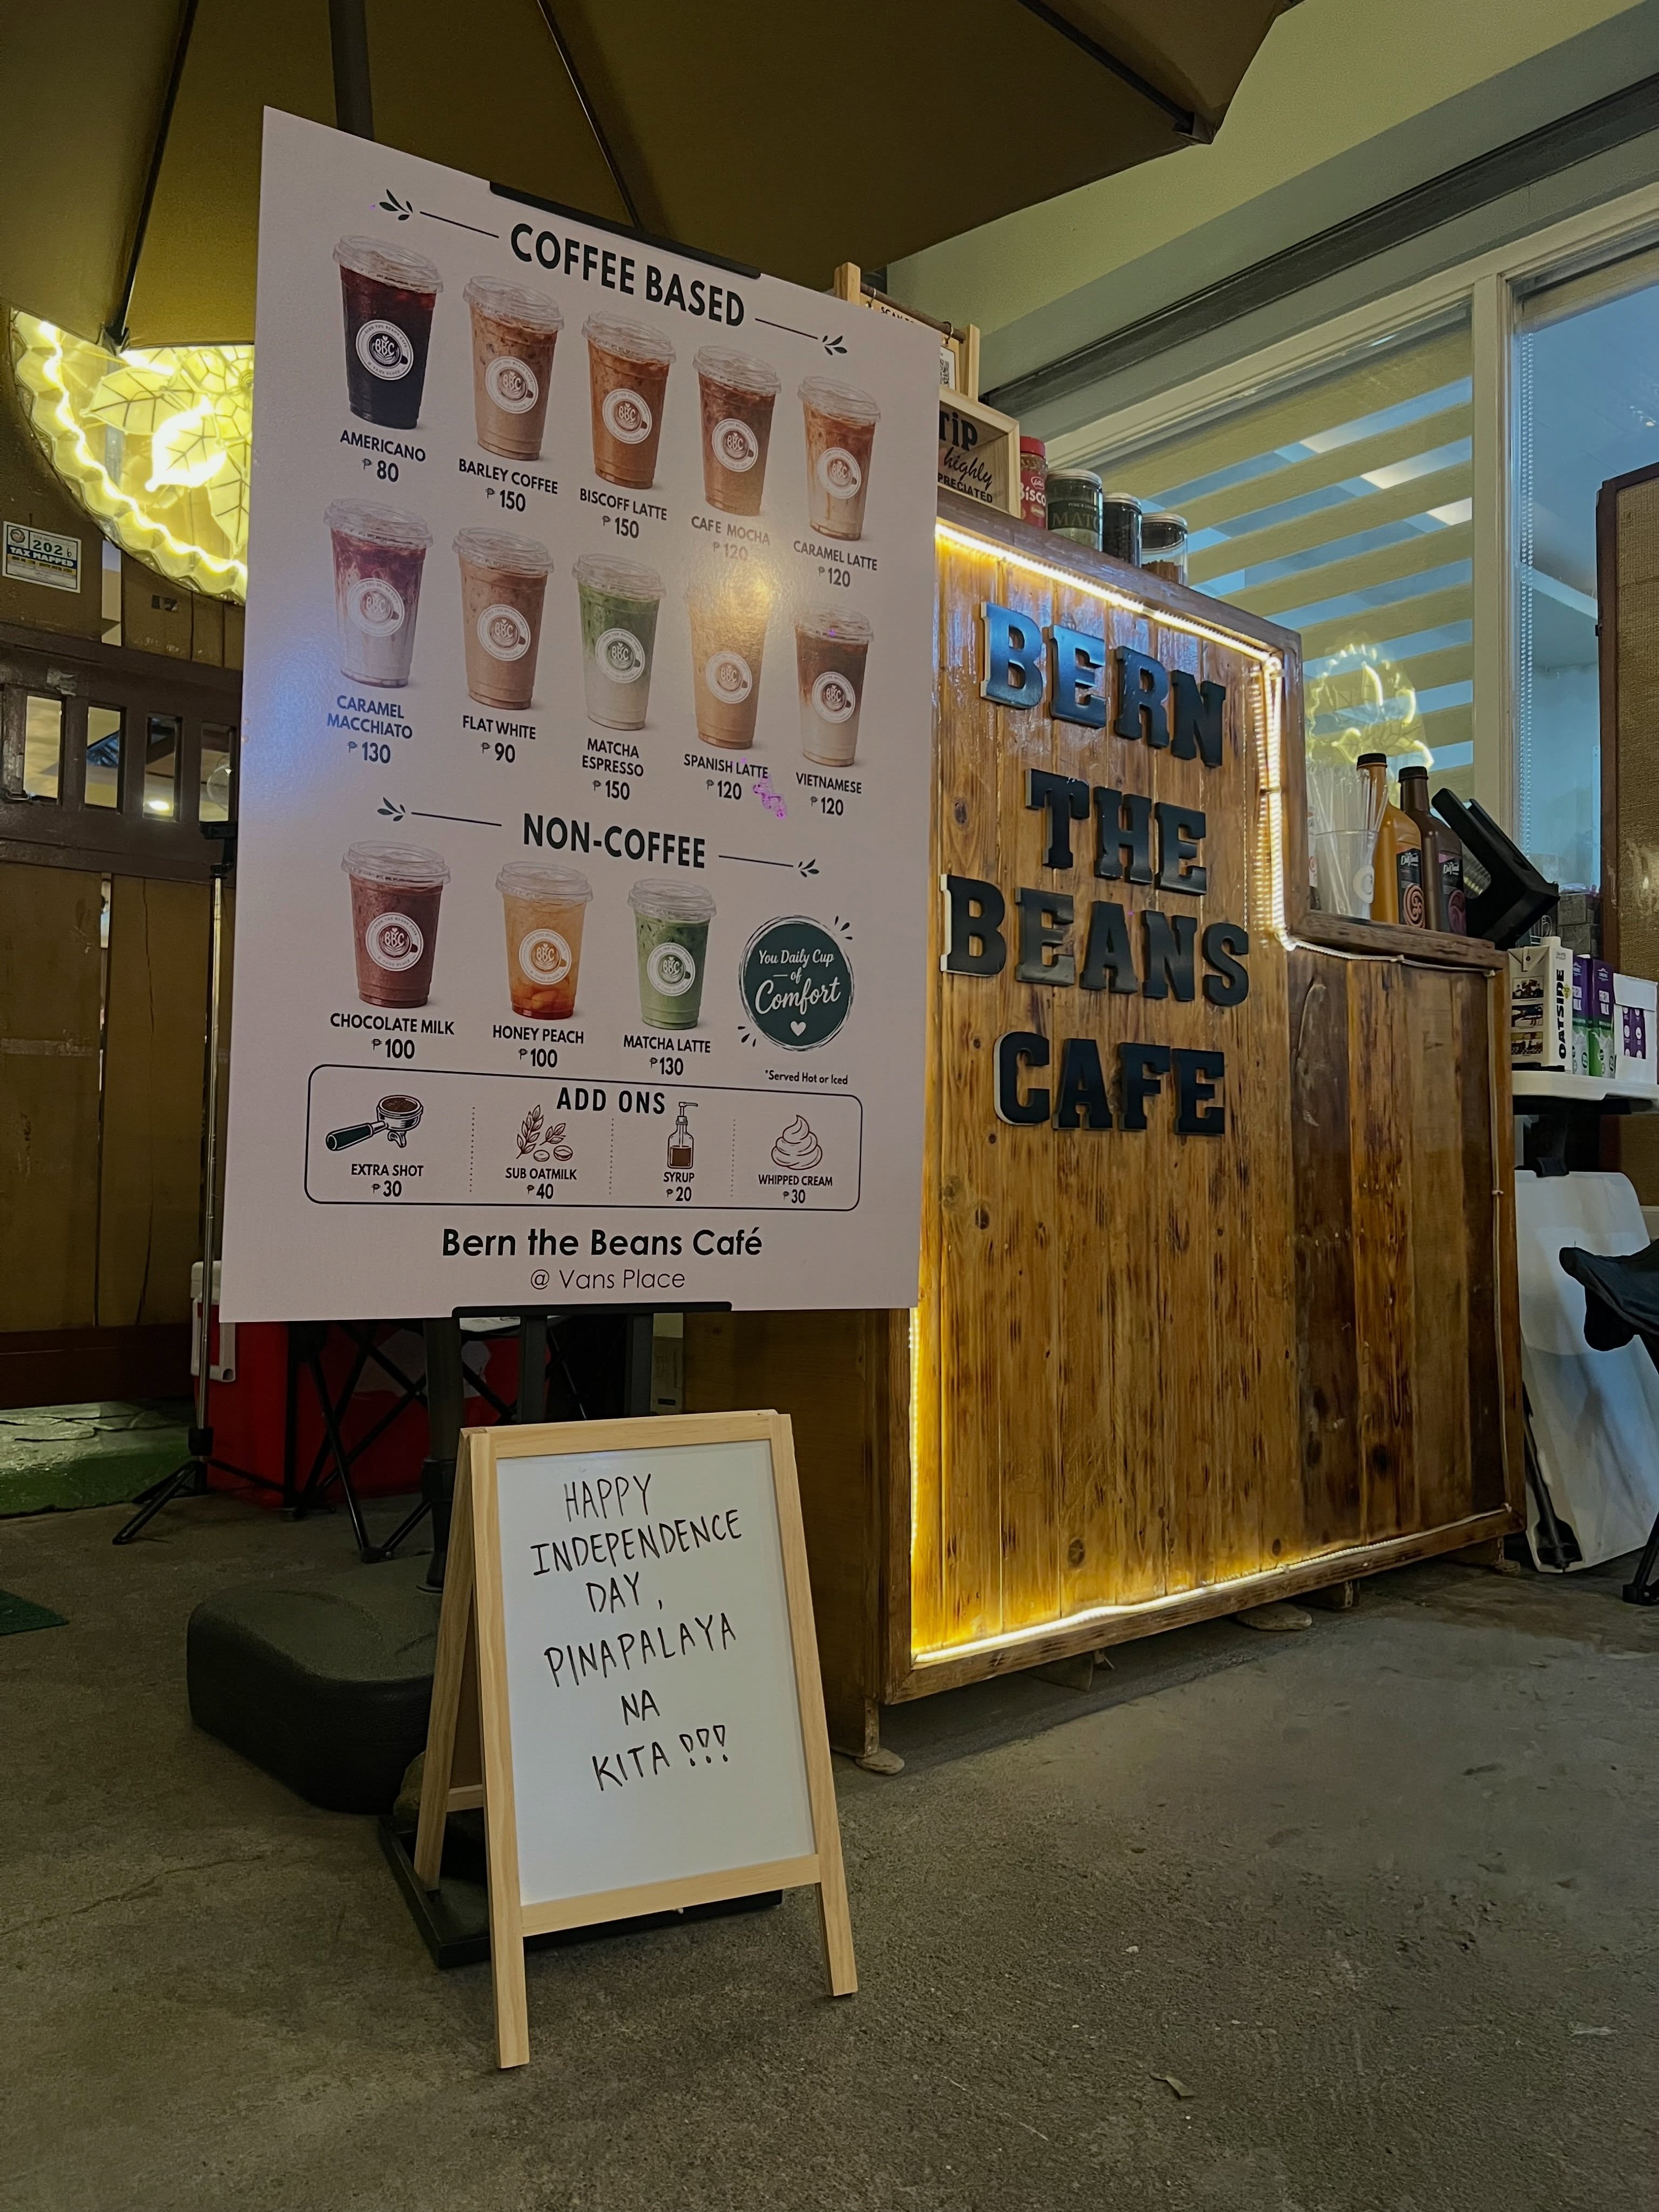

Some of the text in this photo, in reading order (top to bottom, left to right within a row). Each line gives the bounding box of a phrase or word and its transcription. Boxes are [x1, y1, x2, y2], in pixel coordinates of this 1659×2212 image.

[511, 224, 744, 326] COFFEE BASED
[340, 430, 426, 462] AMERICANO
[459, 458, 558, 494] BARLEY COFFEE
[944, 447, 992, 490] highly
[580, 488, 667, 521] BISCOFF LATTE
[692, 516, 771, 545] CAFE MOCHA
[10, 547, 30, 557] TAX
[32, 552, 74, 567] MAPPED
[793, 541, 877, 571] CARAMEL LATTE
[980, 601, 1226, 768] BERN
[337, 695, 404, 719] CARAMEL
[327, 713, 412, 739] MACCHIATO
[463, 715, 536, 740] FLAT WHITE
[588, 738, 639, 758] MATCHA
[582, 755, 643, 777] ESPRESSO
[684, 754, 768, 779] SPANISH LATTE
[796, 772, 861, 794] VIETNAMESE
[524, 813, 705, 868] NON-COFFEE
[1024, 767, 1207, 896] THE
[939, 873, 1250, 1007] BEANS
[759, 948, 834, 968] You Daily Cup
[790, 967, 802, 984] of
[755, 976, 841, 1015] Comfort
[331, 1013, 455, 1035] CHOCOLATE MILK
[1556, 969, 1566, 1059] OATSIDE
[493, 1024, 583, 1044] HONEY PEACH
[624, 1035, 710, 1053] MATCHA LATTE
[802, 1072, 817, 1083] Hot
[831, 1074, 848, 1084] Iced
[993, 1031, 1225, 1136] CAFE
[557, 1087, 665, 1114] ADD ONS
[352, 1164, 423, 1176] EXTRA SHOT
[505, 1168, 577, 1179] SUB OATMILK
[663, 1172, 694, 1183] SYRUP
[758, 1175, 832, 1186] WHIPPED CREAM
[443, 1227, 761, 1256] Bern the Beans Café
[531, 1269, 685, 1290] @ Vans Place
[563, 1473, 651, 1522] HAPPY
[530, 1509, 742, 1576] INDEPENDENCE
[544, 1612, 736, 1688] PINAPALAYA
[621, 1689, 660, 1725] NA
